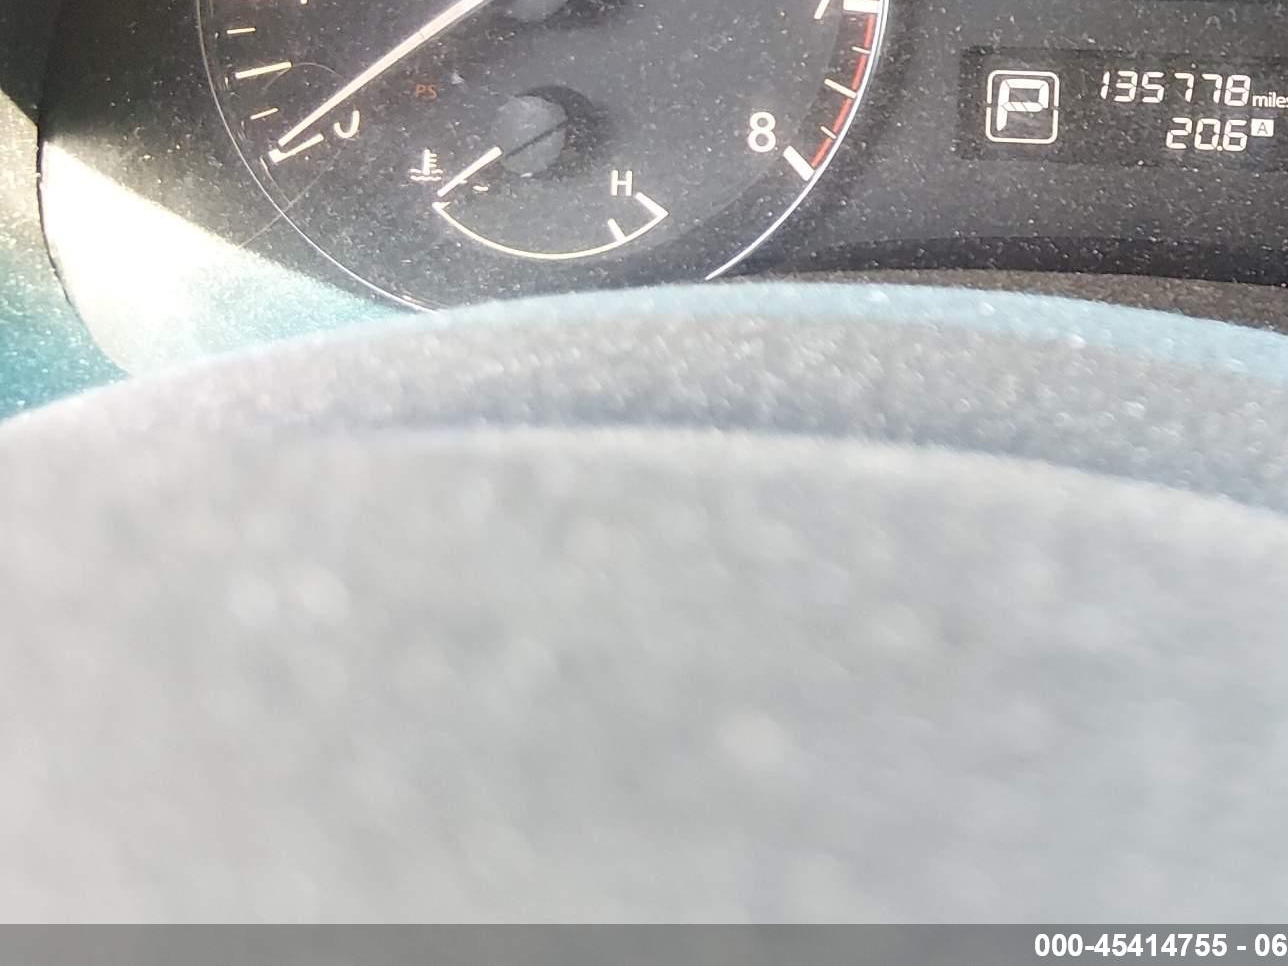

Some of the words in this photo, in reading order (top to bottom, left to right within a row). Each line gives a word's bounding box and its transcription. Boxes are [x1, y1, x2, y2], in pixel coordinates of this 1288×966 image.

[996, 78, 1050, 131] P
[1100, 70, 1251, 107] 135778
[747, 111, 777, 153] 8
[1165, 117, 1248, 152] 20.6
[610, 169, 633, 197] H
